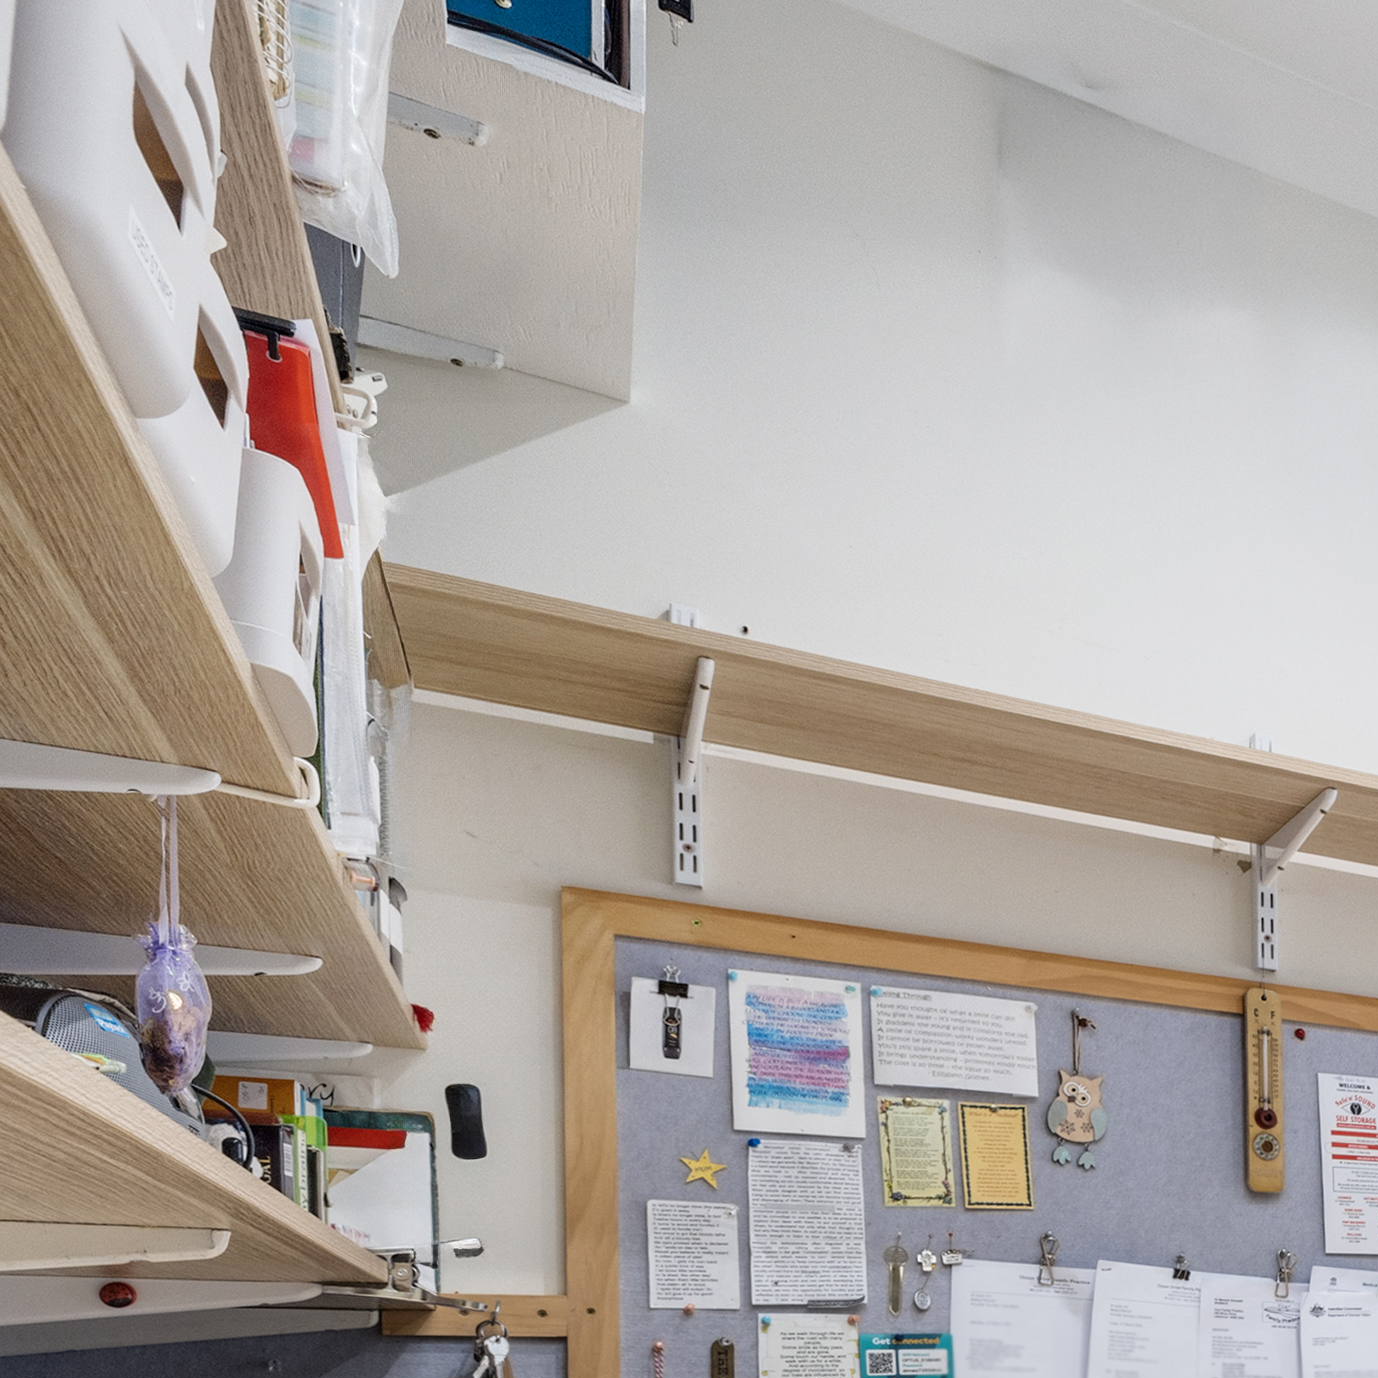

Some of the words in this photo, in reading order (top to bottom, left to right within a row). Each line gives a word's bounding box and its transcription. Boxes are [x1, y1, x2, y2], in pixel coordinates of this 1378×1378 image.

[1355, 1095, 1376, 1109] SOUND
[1351, 1115, 1376, 1124] STORAGE
[872, 1337, 890, 1345] Get
[718, 1350, 728, 1375] THE
